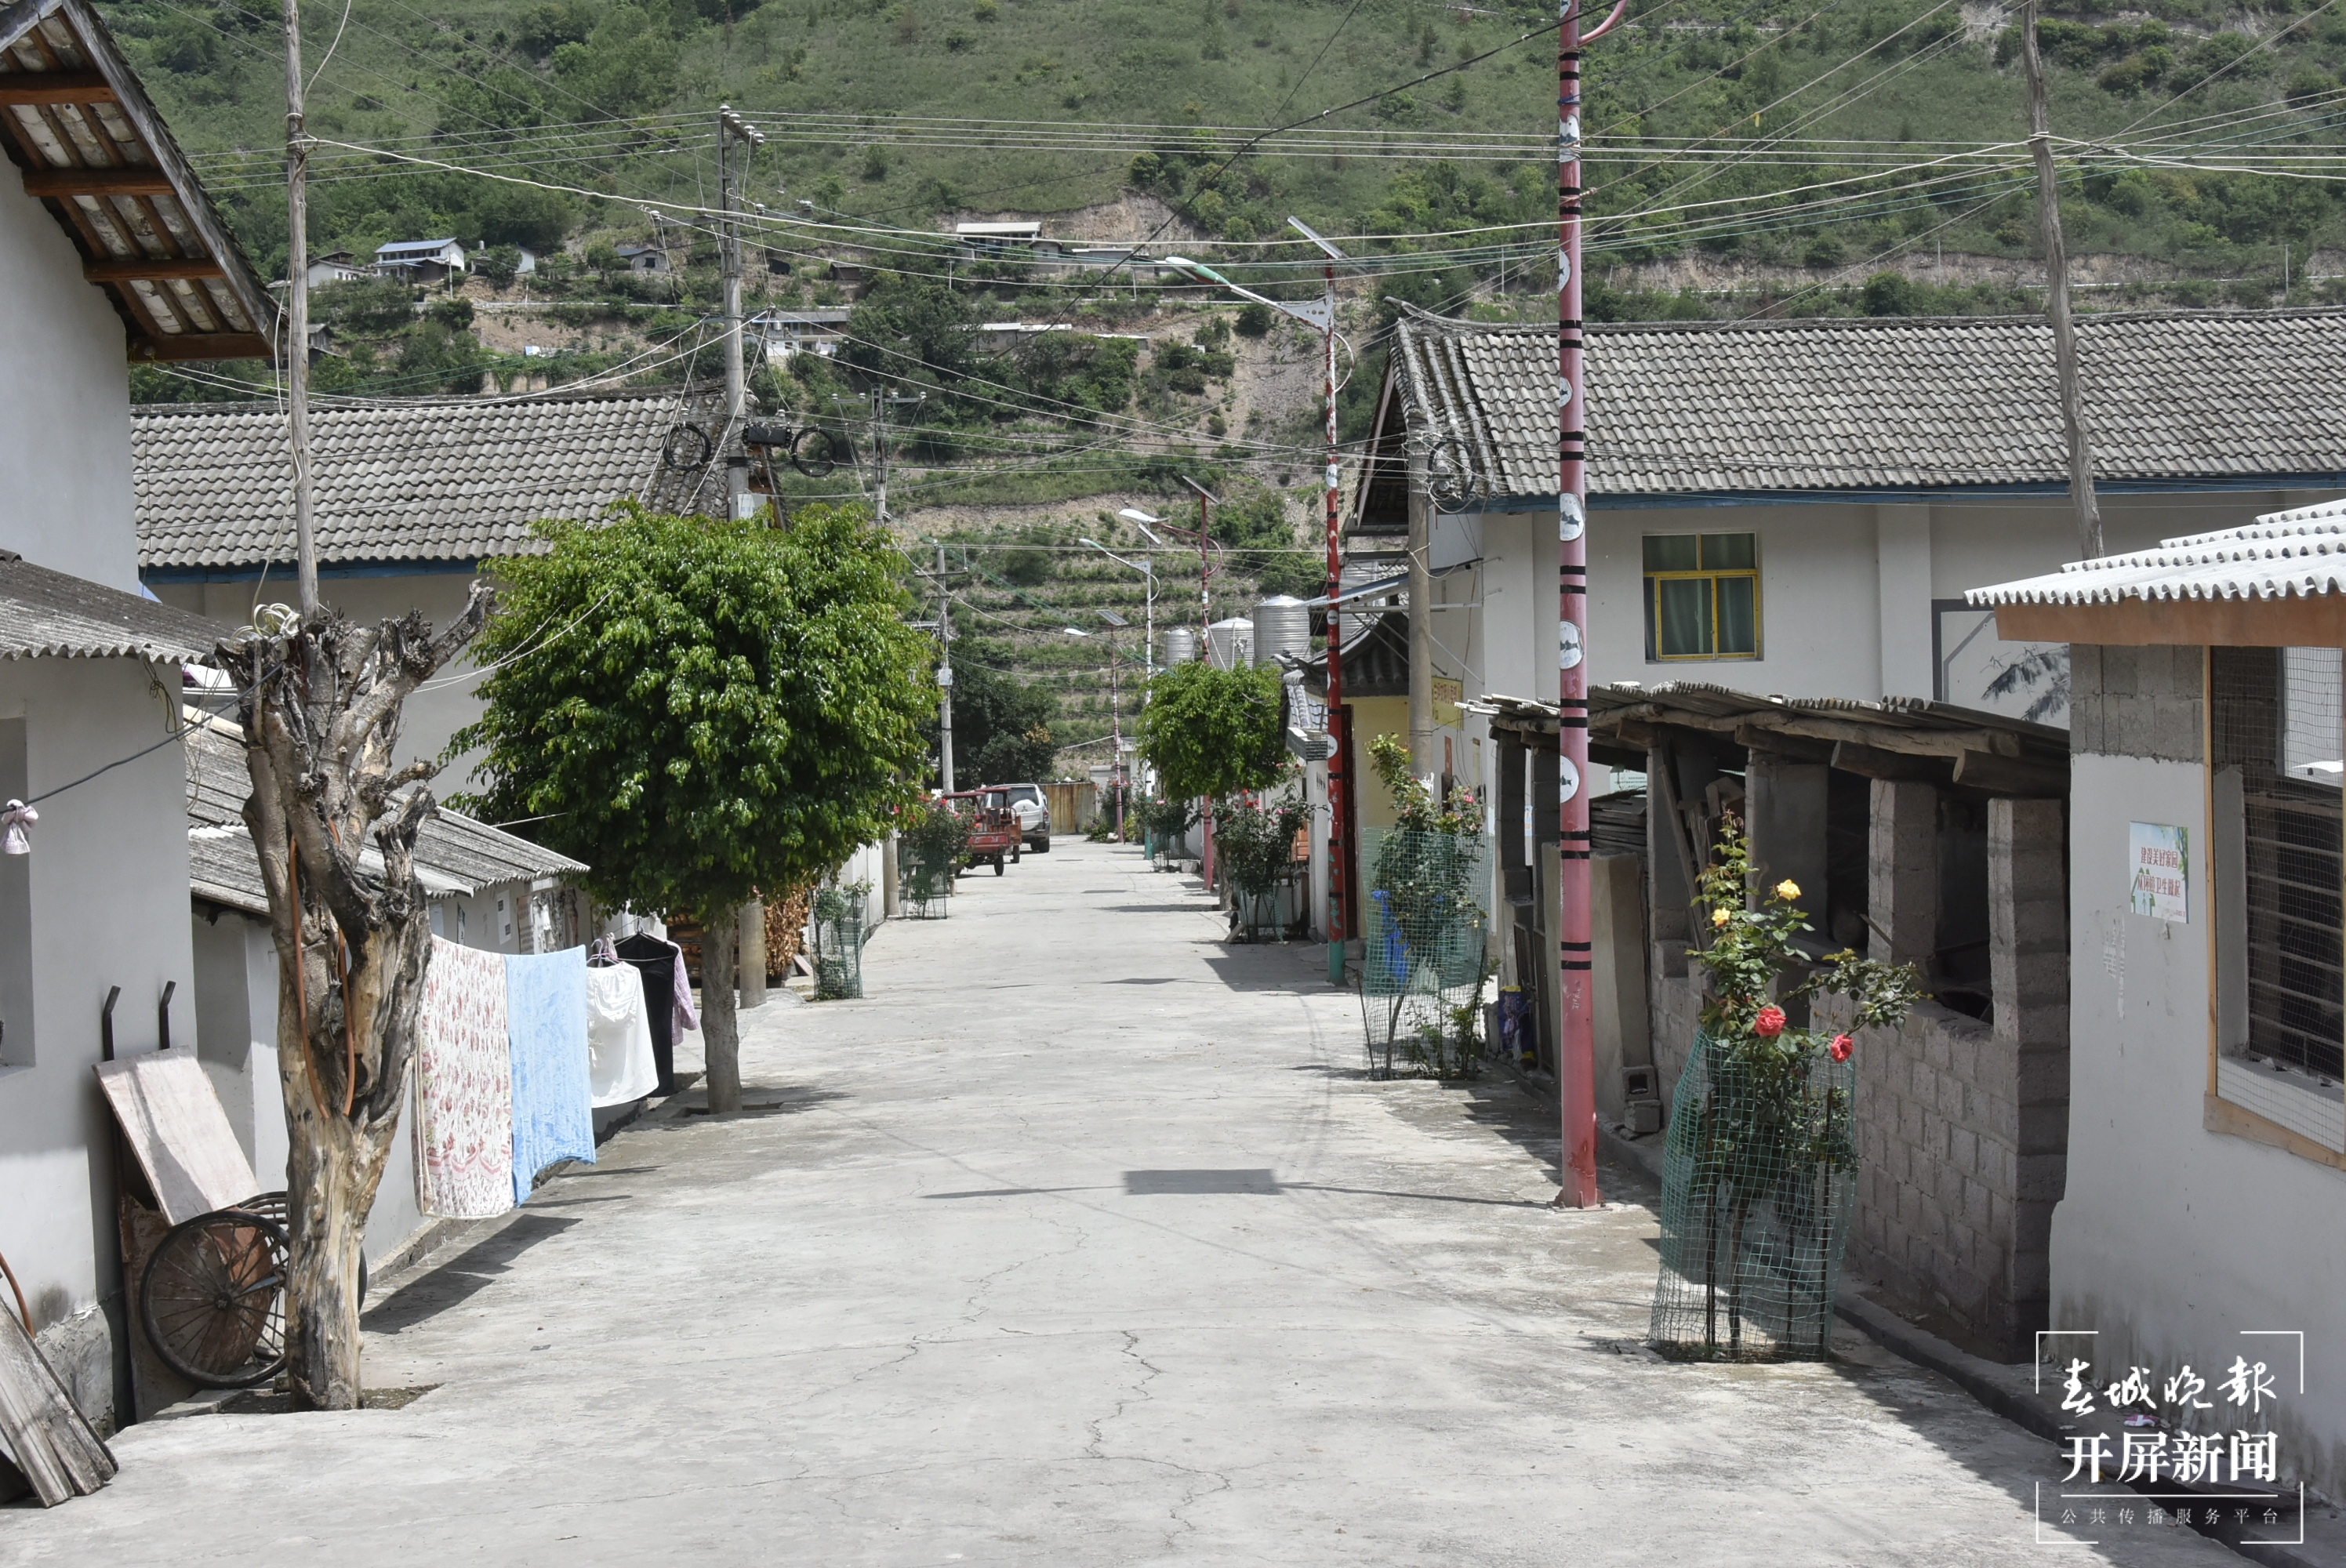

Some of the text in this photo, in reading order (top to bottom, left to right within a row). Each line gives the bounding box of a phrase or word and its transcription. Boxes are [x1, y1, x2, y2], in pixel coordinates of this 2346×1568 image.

[2141, 846, 2178, 869] 建设美好家园
[2137, 873, 2181, 898] 从环境卫生做起
